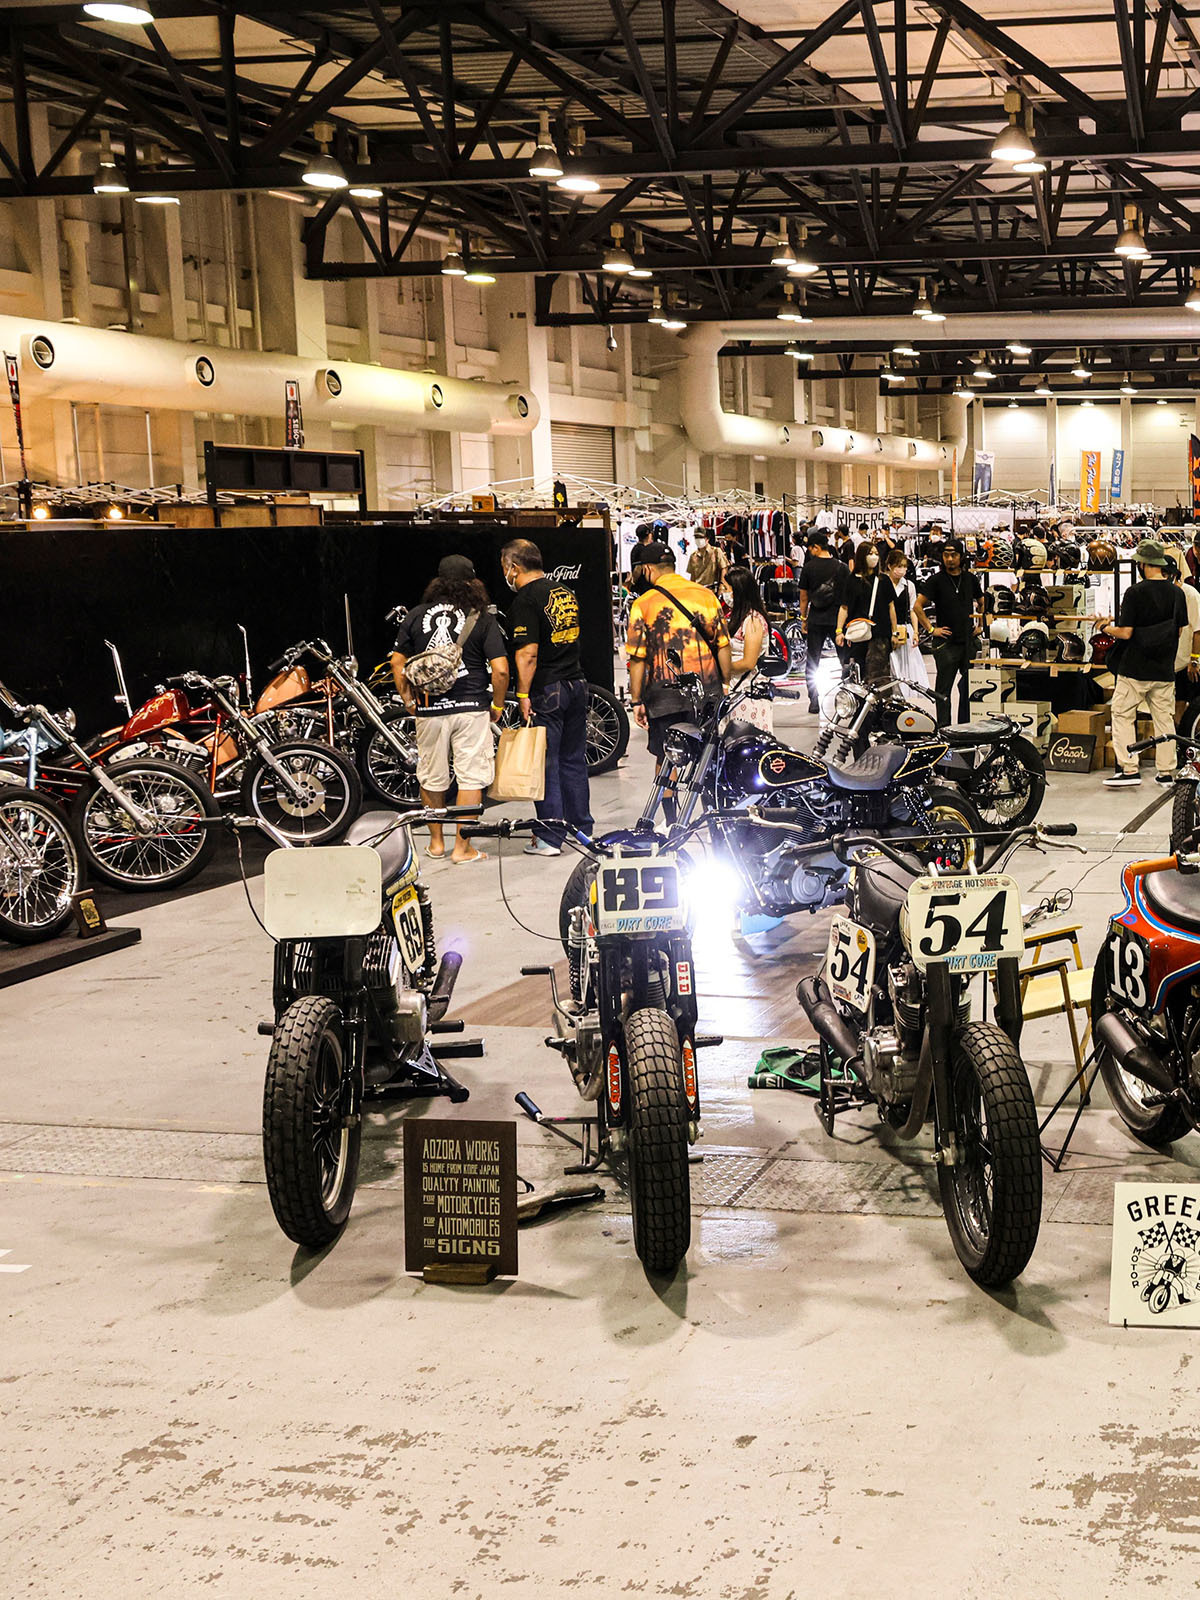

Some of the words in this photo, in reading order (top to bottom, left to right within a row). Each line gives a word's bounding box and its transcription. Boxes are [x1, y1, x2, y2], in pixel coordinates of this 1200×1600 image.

[603, 867, 679, 912] 89
[616, 917, 642, 931] DIRT
[644, 916, 673, 930] CORE
[920, 890, 1009, 957] 54
[830, 931, 870, 997] 54
[969, 953, 997, 969] CORE
[1110, 936, 1147, 1008] 13
[422, 1138, 462, 1161] AOZORA
[465, 1140, 500, 1162] WORKS
[430, 1163, 446, 1174] HOME
[447, 1164, 462, 1174] FROM
[463, 1164, 478, 1175] KOBE
[479, 1165, 500, 1175] JAPAN
[422, 1176, 460, 1193] QUALYTY
[463, 1178, 501, 1194] PAINTING
[437, 1196, 500, 1216] MOTORCYCLES
[437, 1217, 500, 1237] AUTOMOBILES
[437, 1238, 501, 1256] SIGNS
[1130, 1246, 1142, 1289] MOTOR
